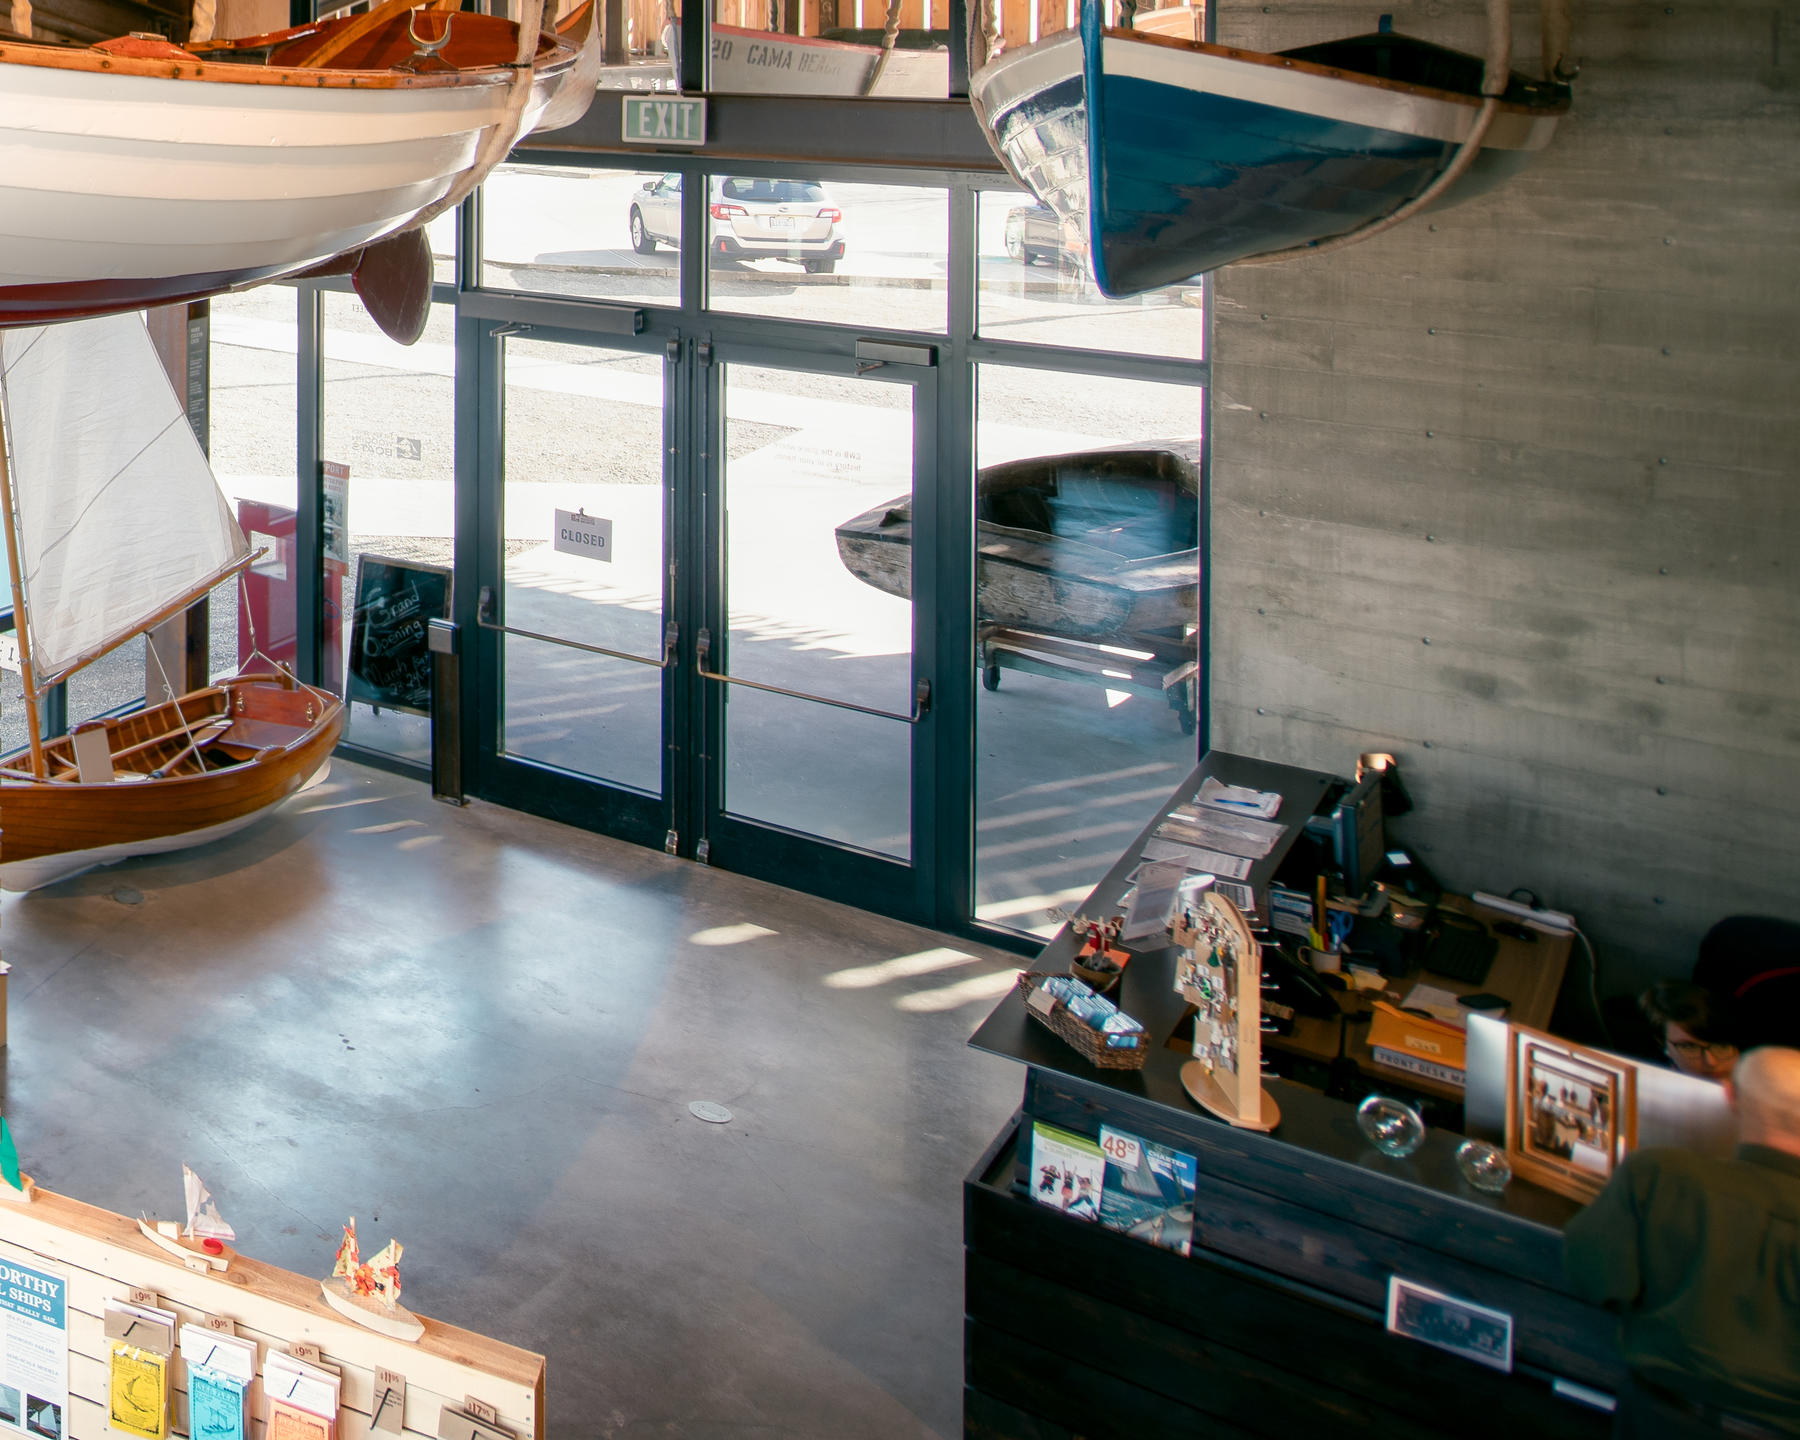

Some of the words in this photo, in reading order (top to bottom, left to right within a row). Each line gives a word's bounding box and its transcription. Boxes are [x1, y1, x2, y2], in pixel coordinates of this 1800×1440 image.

[746, 45, 792, 71] CAMA
[638, 103, 693, 138] EXIT
[561, 529, 605, 547] CLOSED
[365, 620, 425, 657] Opening
[1380, 1053, 1414, 1071] FRONT
[1419, 1061, 1447, 1079] DESK
[9, 1288, 52, 1313] SHIPS
[16, 1304, 41, 1319] REALLY
